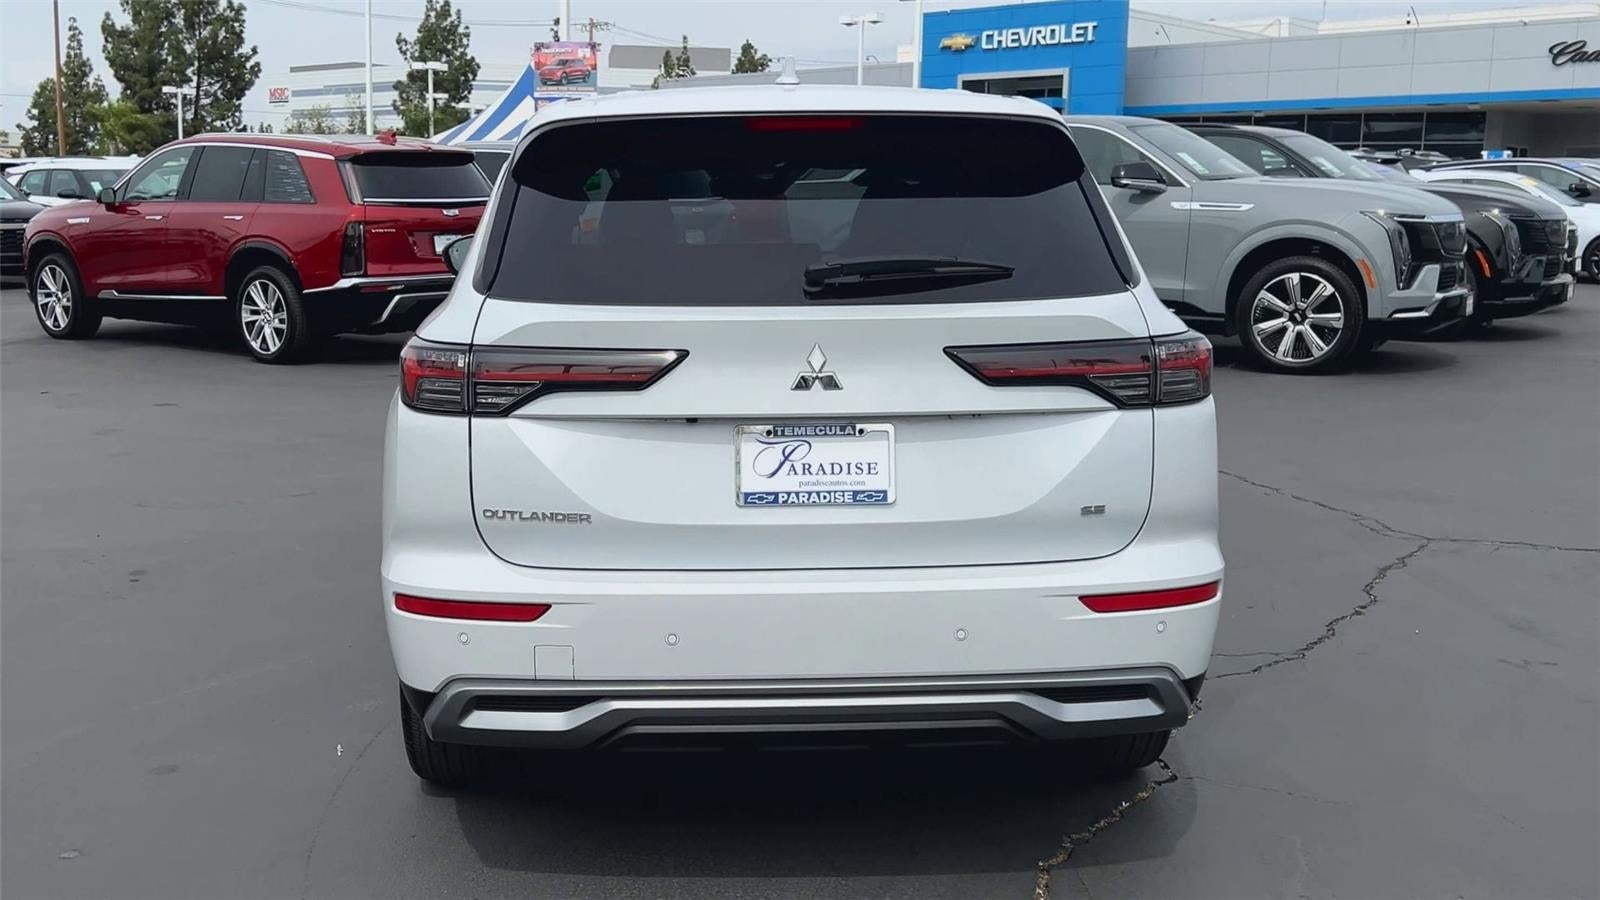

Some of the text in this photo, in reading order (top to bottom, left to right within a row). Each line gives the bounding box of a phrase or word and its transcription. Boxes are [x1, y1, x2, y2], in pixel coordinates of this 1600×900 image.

[981, 21, 1098, 50] CHEVROLET
[775, 425, 855, 436] TEMECULA
[752, 438, 879, 478] PARADISE
[798, 479, 866, 488] paradiseautos.com
[778, 491, 854, 504] PARADISE
[482, 508, 593, 524] OUTLANDER
[1080, 505, 1106, 516] SE
